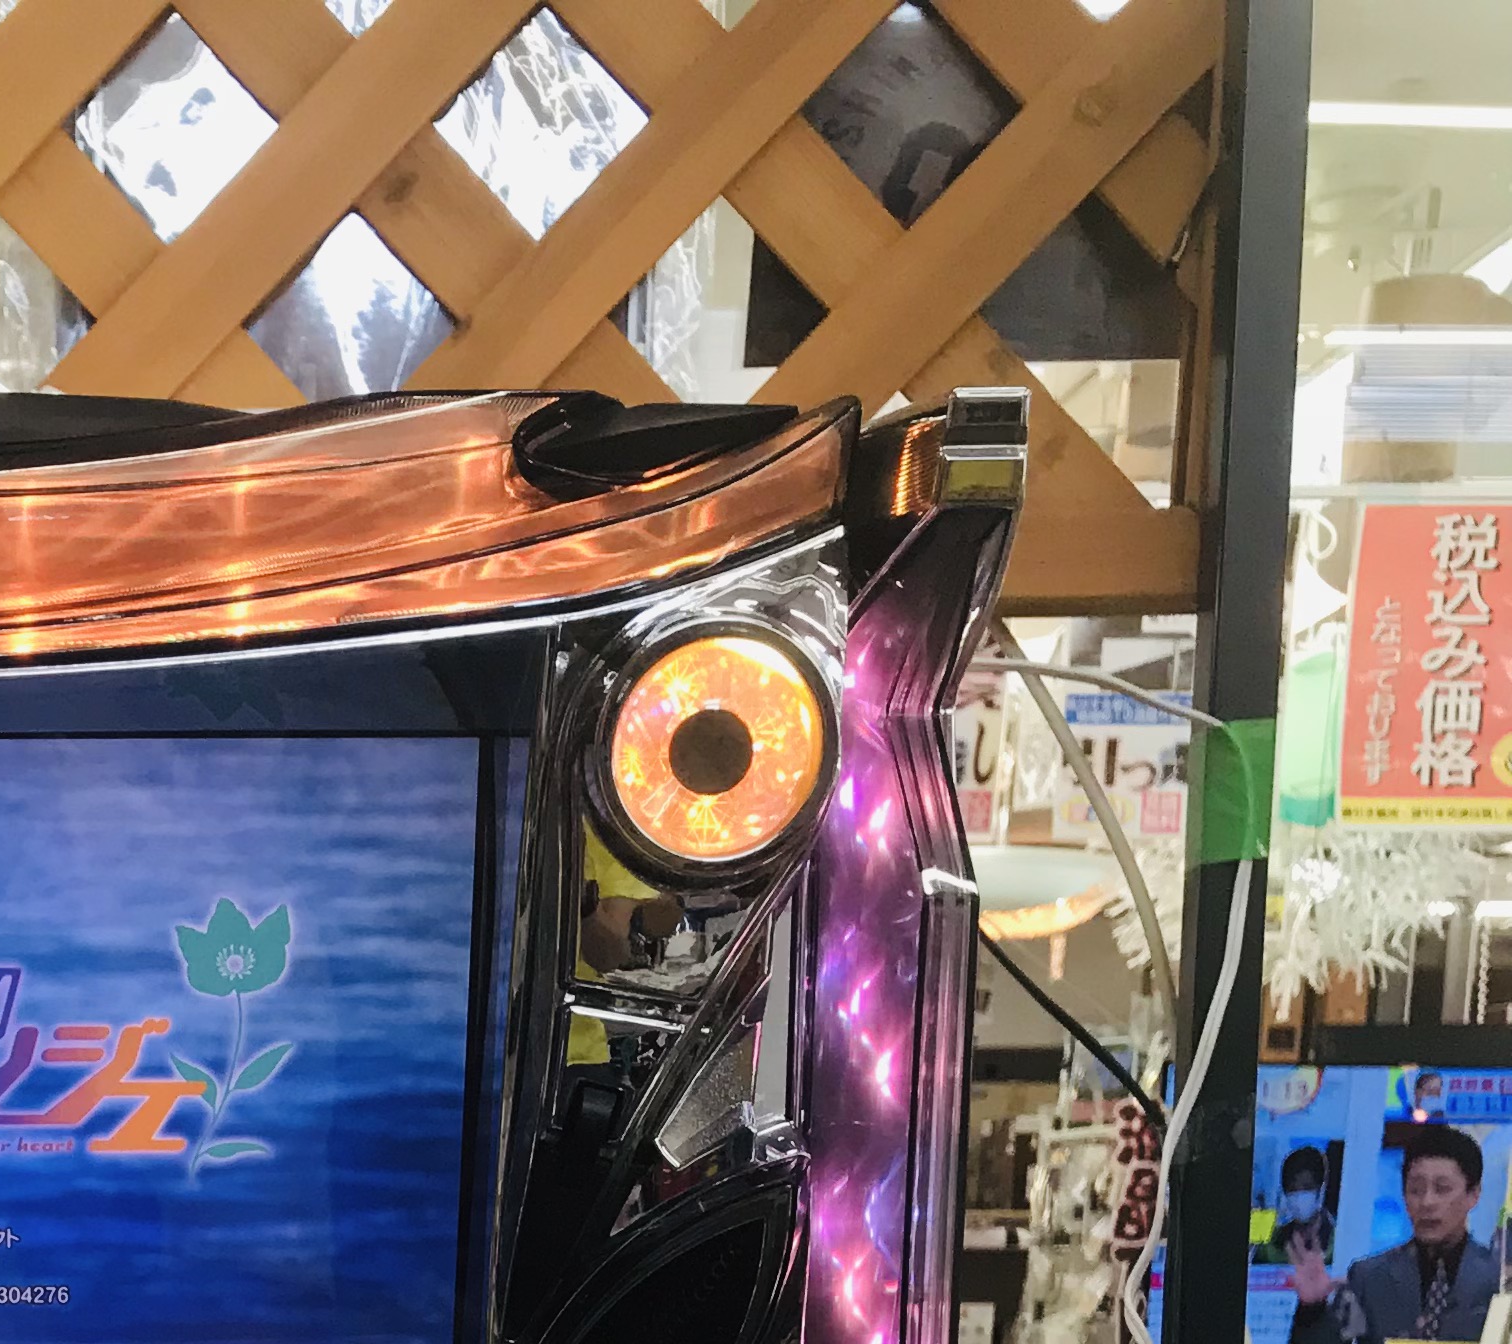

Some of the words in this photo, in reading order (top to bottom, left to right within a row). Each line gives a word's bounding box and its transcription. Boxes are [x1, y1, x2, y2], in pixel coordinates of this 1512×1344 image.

[1411, 513, 1500, 788] 税込み価格
[17, 1137, 74, 1153] heart
